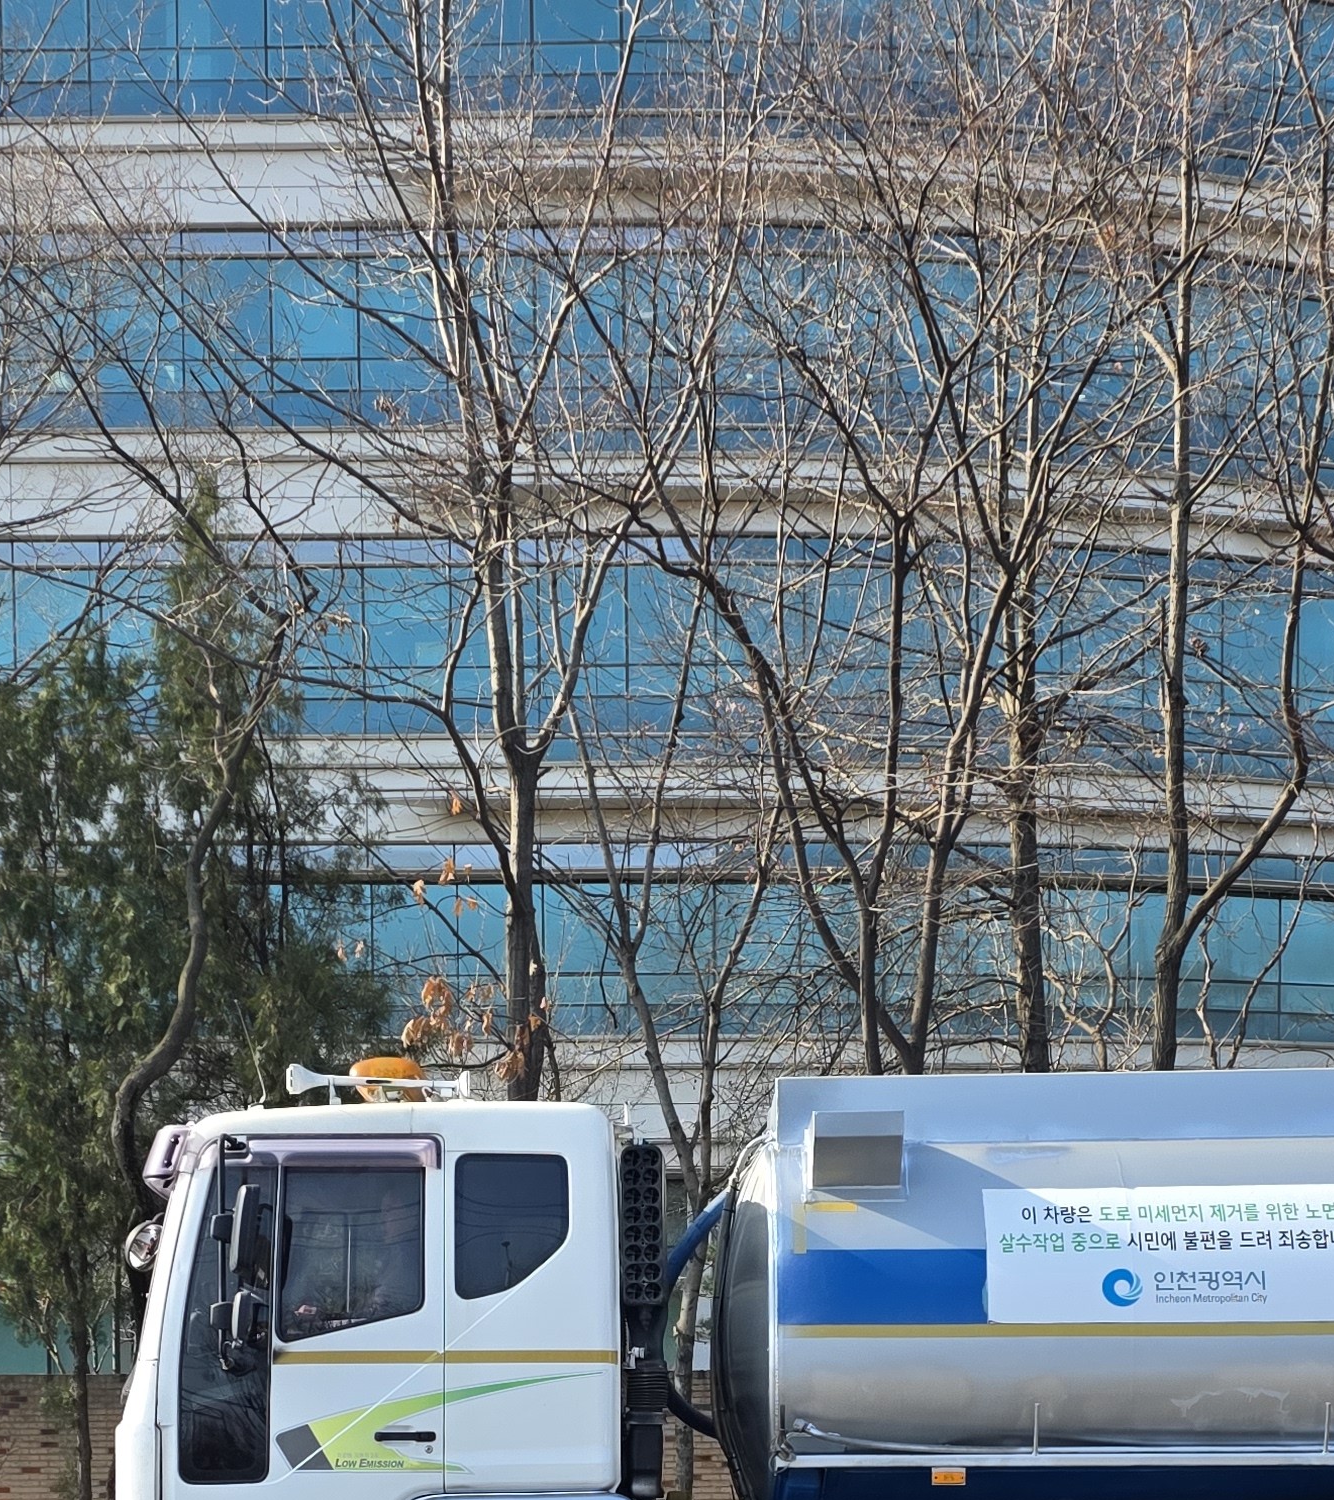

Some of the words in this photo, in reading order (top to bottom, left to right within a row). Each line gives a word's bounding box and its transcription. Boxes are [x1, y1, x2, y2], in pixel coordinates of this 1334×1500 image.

[1020, 1206, 1037, 1225] 이
[1043, 1205, 1093, 1225] 차량은
[1098, 1205, 1133, 1222] 도로
[1137, 1203, 1204, 1224] 미세먼지
[1209, 1203, 1260, 1223] 제거를
[1265, 1202, 1299, 1222] 위한
[999, 1232, 1065, 1253] 살수작업
[1070, 1232, 1122, 1253] 중으로
[1127, 1230, 1177, 1252] 시민에
[1182, 1229, 1234, 1251] 불편을
[1239, 1229, 1273, 1250] 드려
[1153, 1270, 1267, 1291] 인천광역시
[1155, 1293, 1191, 1304] Incheon
[1193, 1292, 1250, 1305] Metropolitan
[1251, 1292, 1268, 1305] City
